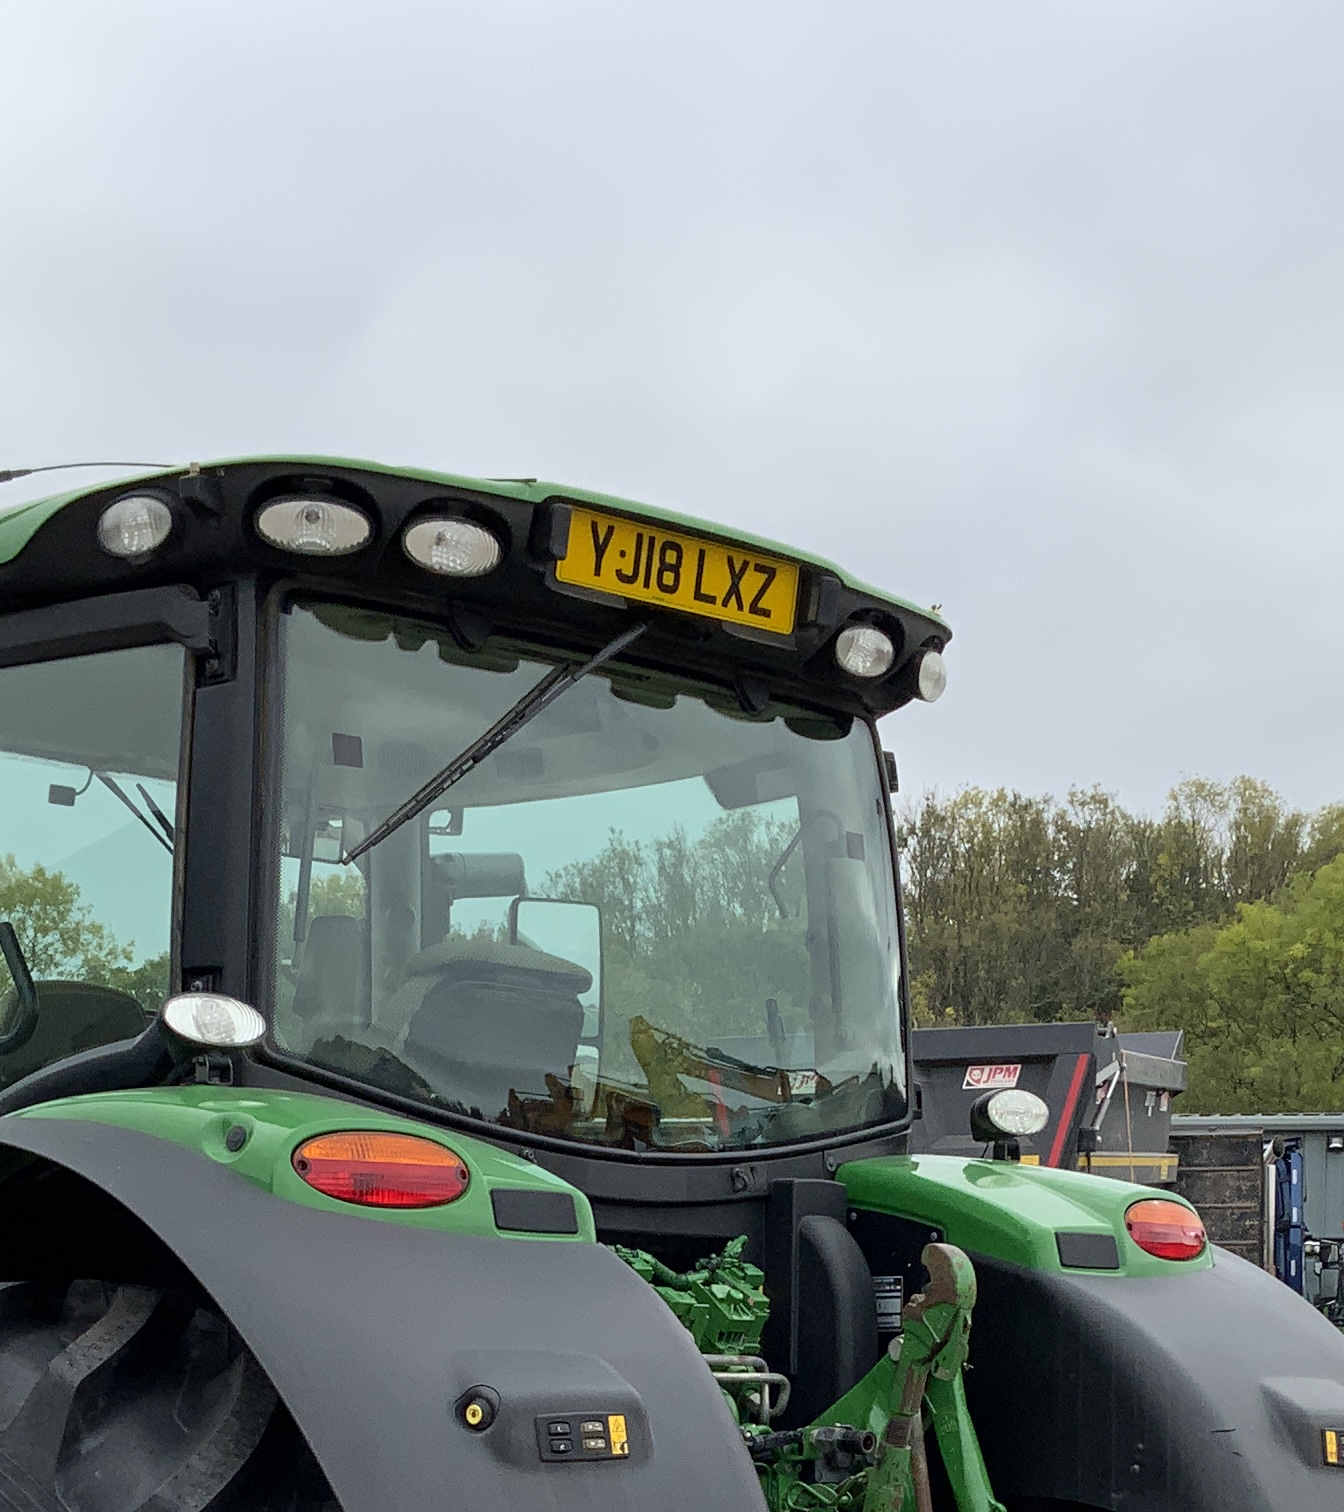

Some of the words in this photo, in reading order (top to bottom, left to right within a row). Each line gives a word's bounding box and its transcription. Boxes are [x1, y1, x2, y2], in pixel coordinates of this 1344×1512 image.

[590, 519, 684, 595] YJ18
[693, 548, 777, 619] LXZ
[983, 1066, 1019, 1084] JPM
